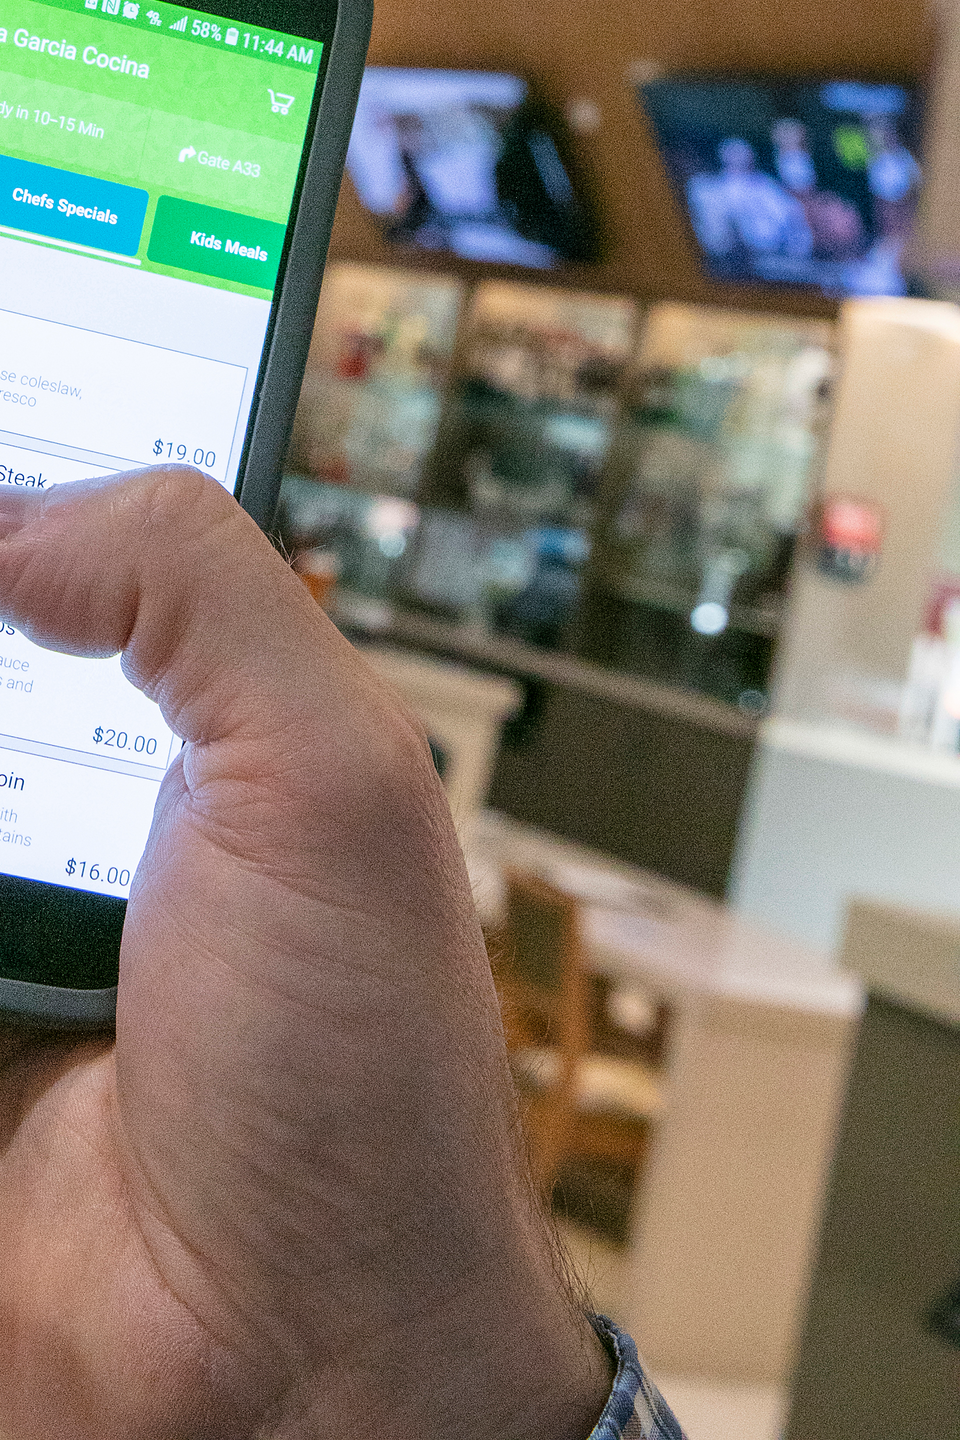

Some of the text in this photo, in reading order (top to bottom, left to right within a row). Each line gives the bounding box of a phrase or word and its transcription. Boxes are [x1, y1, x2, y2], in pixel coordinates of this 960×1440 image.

[13, 27, 78, 61] Garcia
[82, 45, 150, 80] Cocina
[190, 18, 314, 65] 58% 11:44 AM
[15, 104, 30, 121] in
[77, 120, 105, 140] Min
[197, 150, 262, 178] Gate A33
[11, 187, 119, 225] Chefs Specials
[189, 230, 269, 262] Kids Meals
[20, 374, 82, 401] coleslaw,
[151, 436, 218, 469] $19.00
[5, 678, 35, 694] and
[92, 725, 158, 756] $20.00
[64, 857, 131, 887] $16.00
